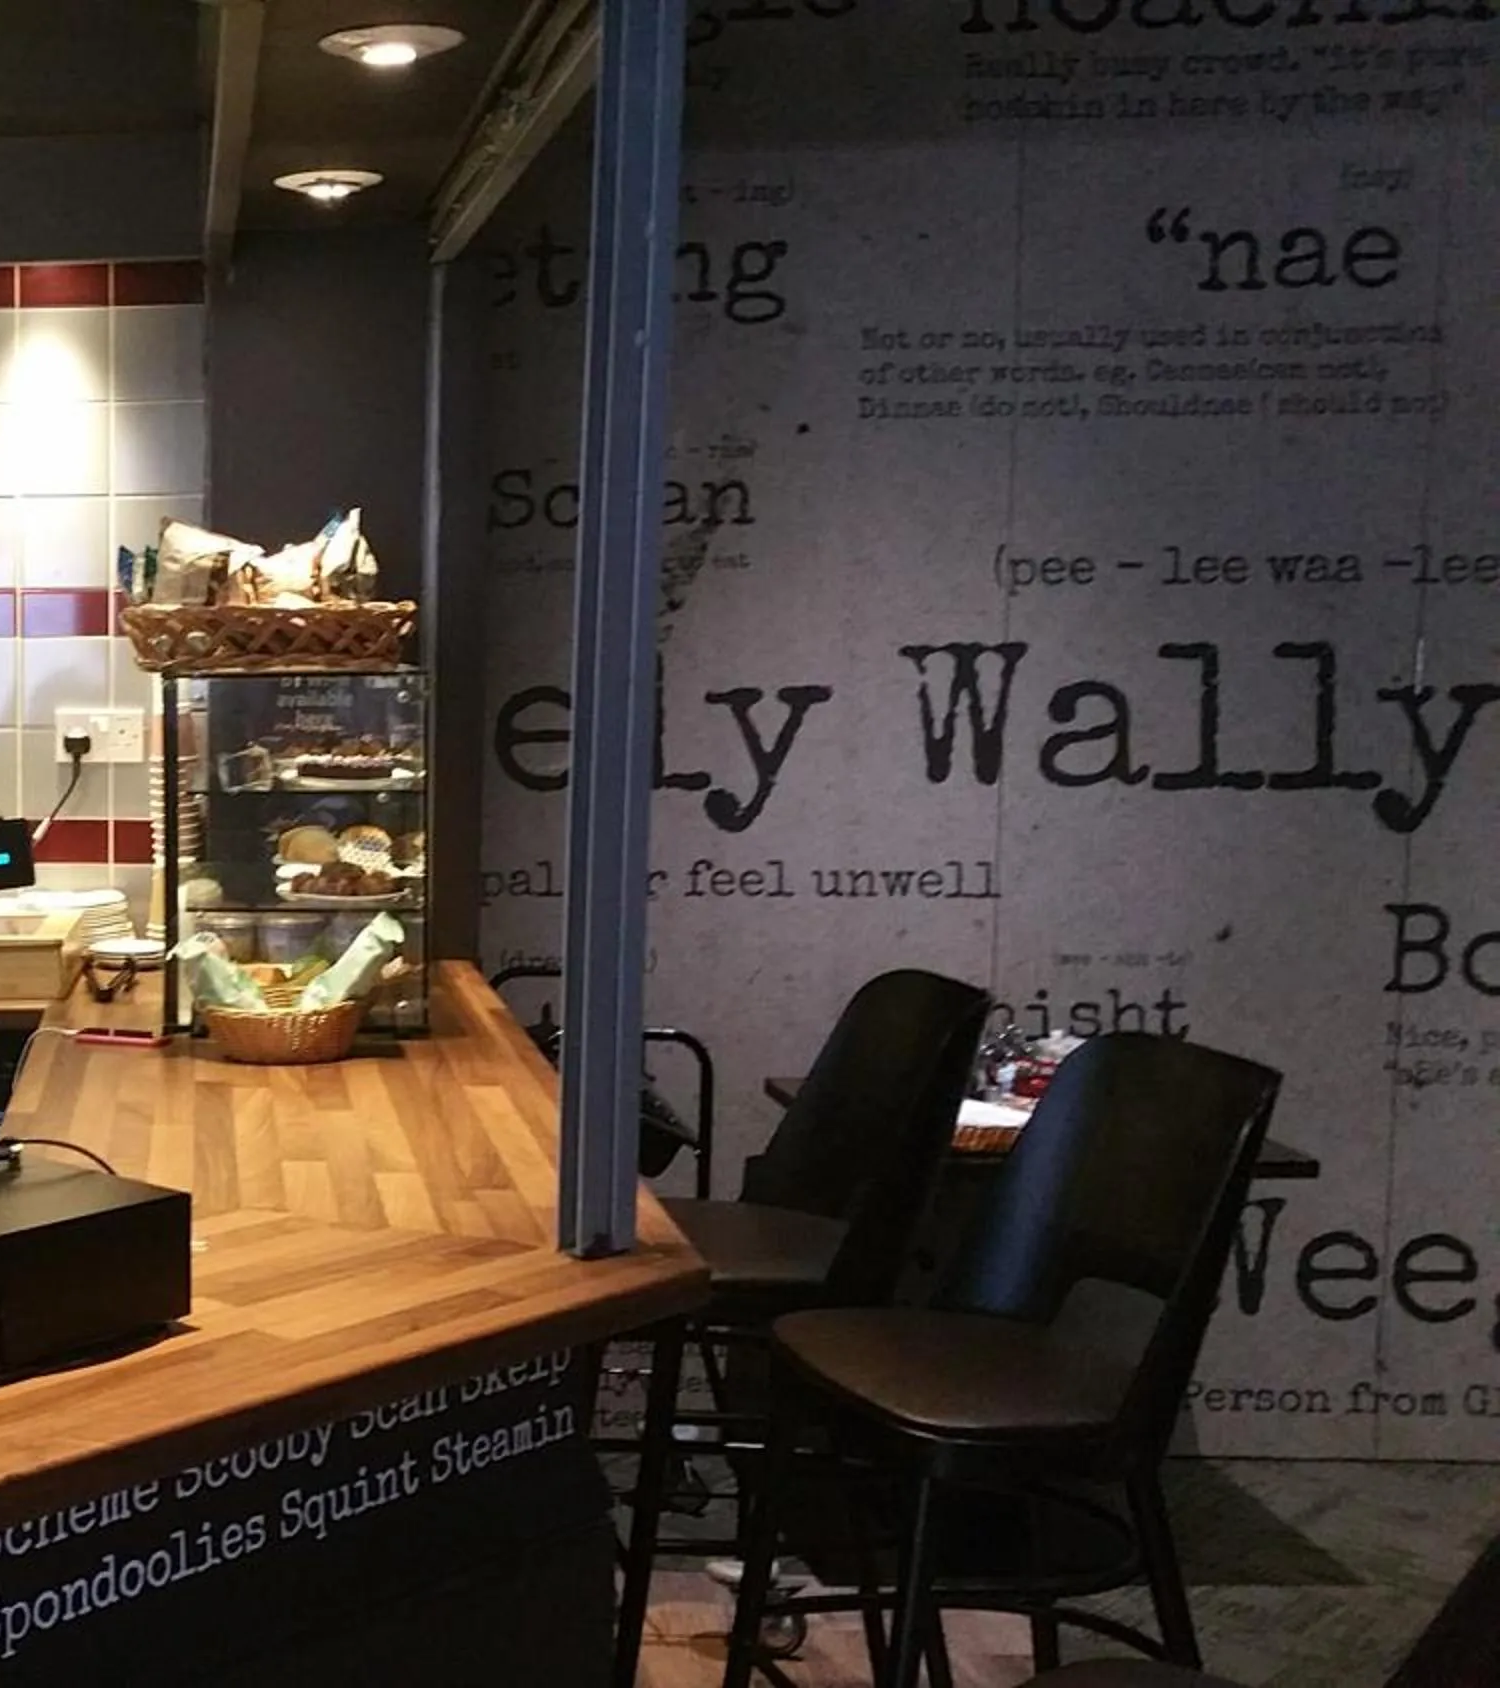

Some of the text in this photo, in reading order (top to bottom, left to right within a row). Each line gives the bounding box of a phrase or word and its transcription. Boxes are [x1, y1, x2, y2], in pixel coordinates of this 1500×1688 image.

[918, 331, 955, 350] or
[898, 363, 982, 385] other
[1159, 544, 1253, 587] lee
[1266, 551, 1364, 585] waa
[897, 639, 1500, 836] Wally
[684, 857, 797, 900] feel
[810, 858, 1002, 900] unwell
[1344, 1380, 1449, 1416] from
[278, 1448, 422, 1542] Squint
[430, 1402, 577, 1486] Steamin
